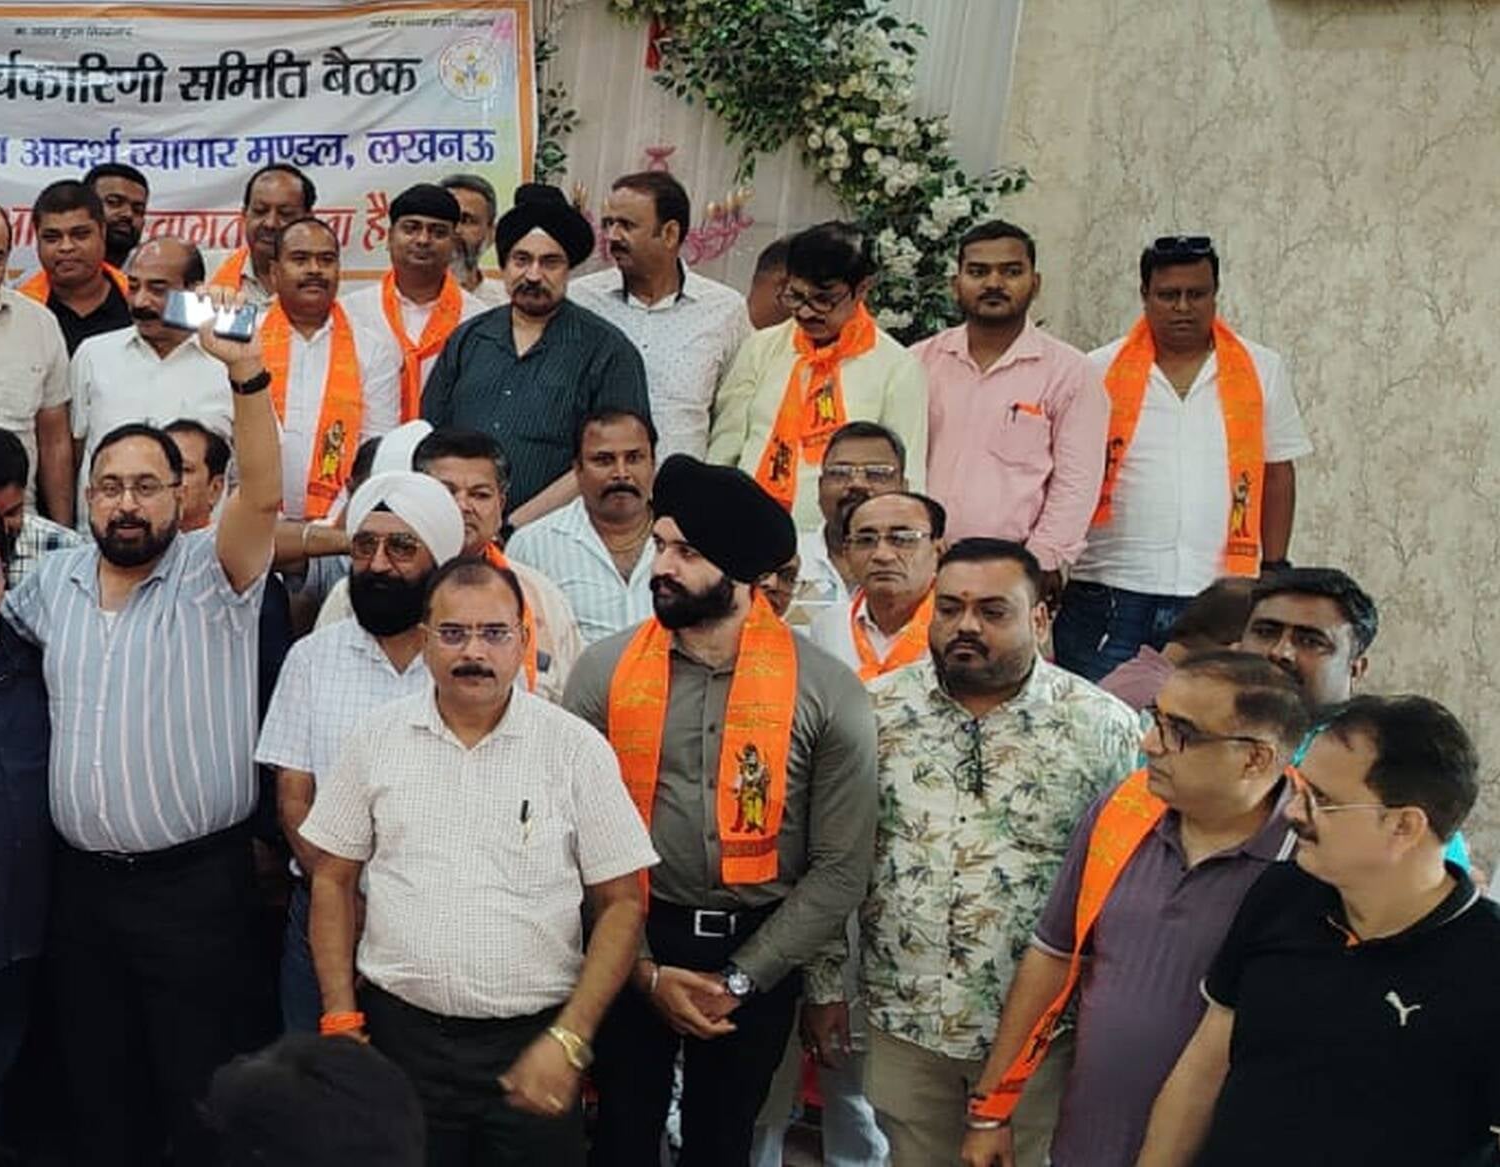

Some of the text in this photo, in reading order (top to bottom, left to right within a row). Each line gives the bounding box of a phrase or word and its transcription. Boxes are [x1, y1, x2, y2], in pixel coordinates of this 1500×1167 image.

[178, 51, 310, 101] समिति
[322, 46, 422, 97] बैठक
[20, 127, 121, 168] आदर्श
[130, 138, 239, 170] व्यापार
[246, 133, 355, 170] मण्डल,
[367, 129, 497, 164] लखनऊ
